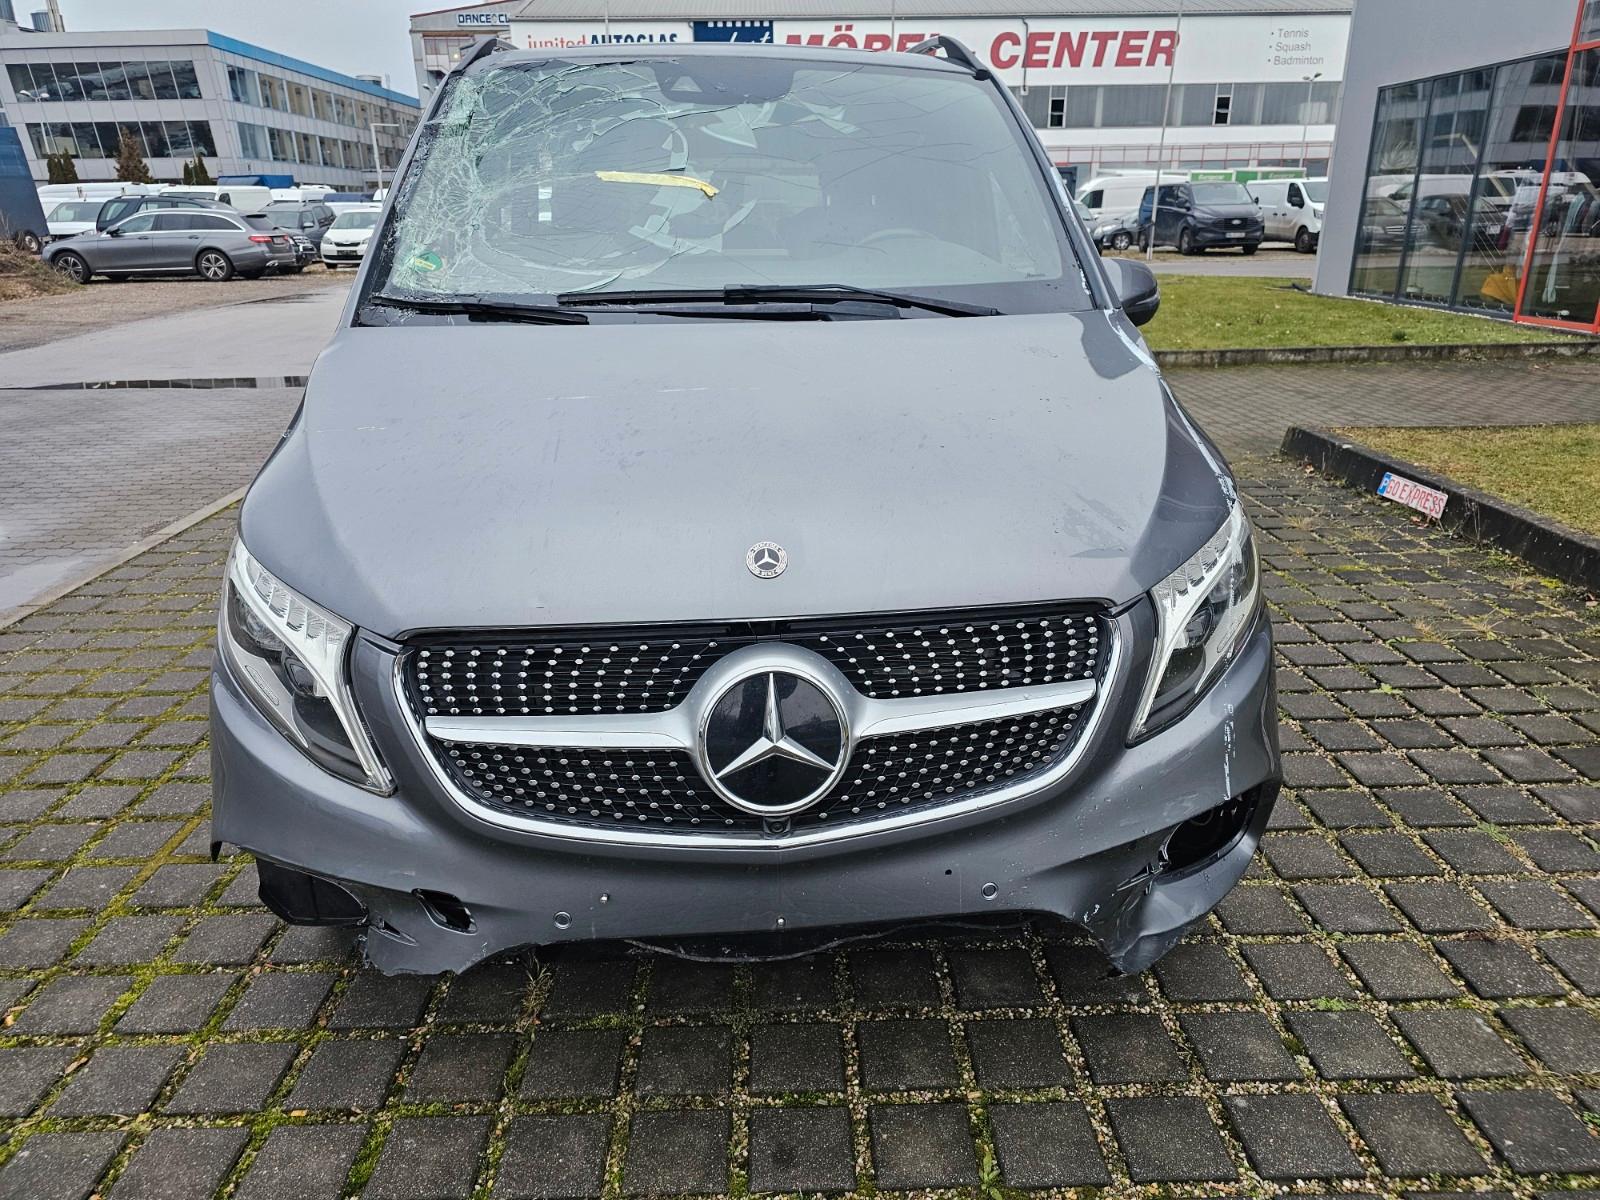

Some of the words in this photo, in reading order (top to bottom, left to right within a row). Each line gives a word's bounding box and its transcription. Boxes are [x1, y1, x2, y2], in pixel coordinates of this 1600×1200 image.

[458, 14, 491, 24] DANCE
[1278, 28, 1309, 38] Tennis
[989, 31, 1180, 69] CENTER
[1275, 41, 1311, 53] Squash
[1273, 55, 1324, 65] Badminton
